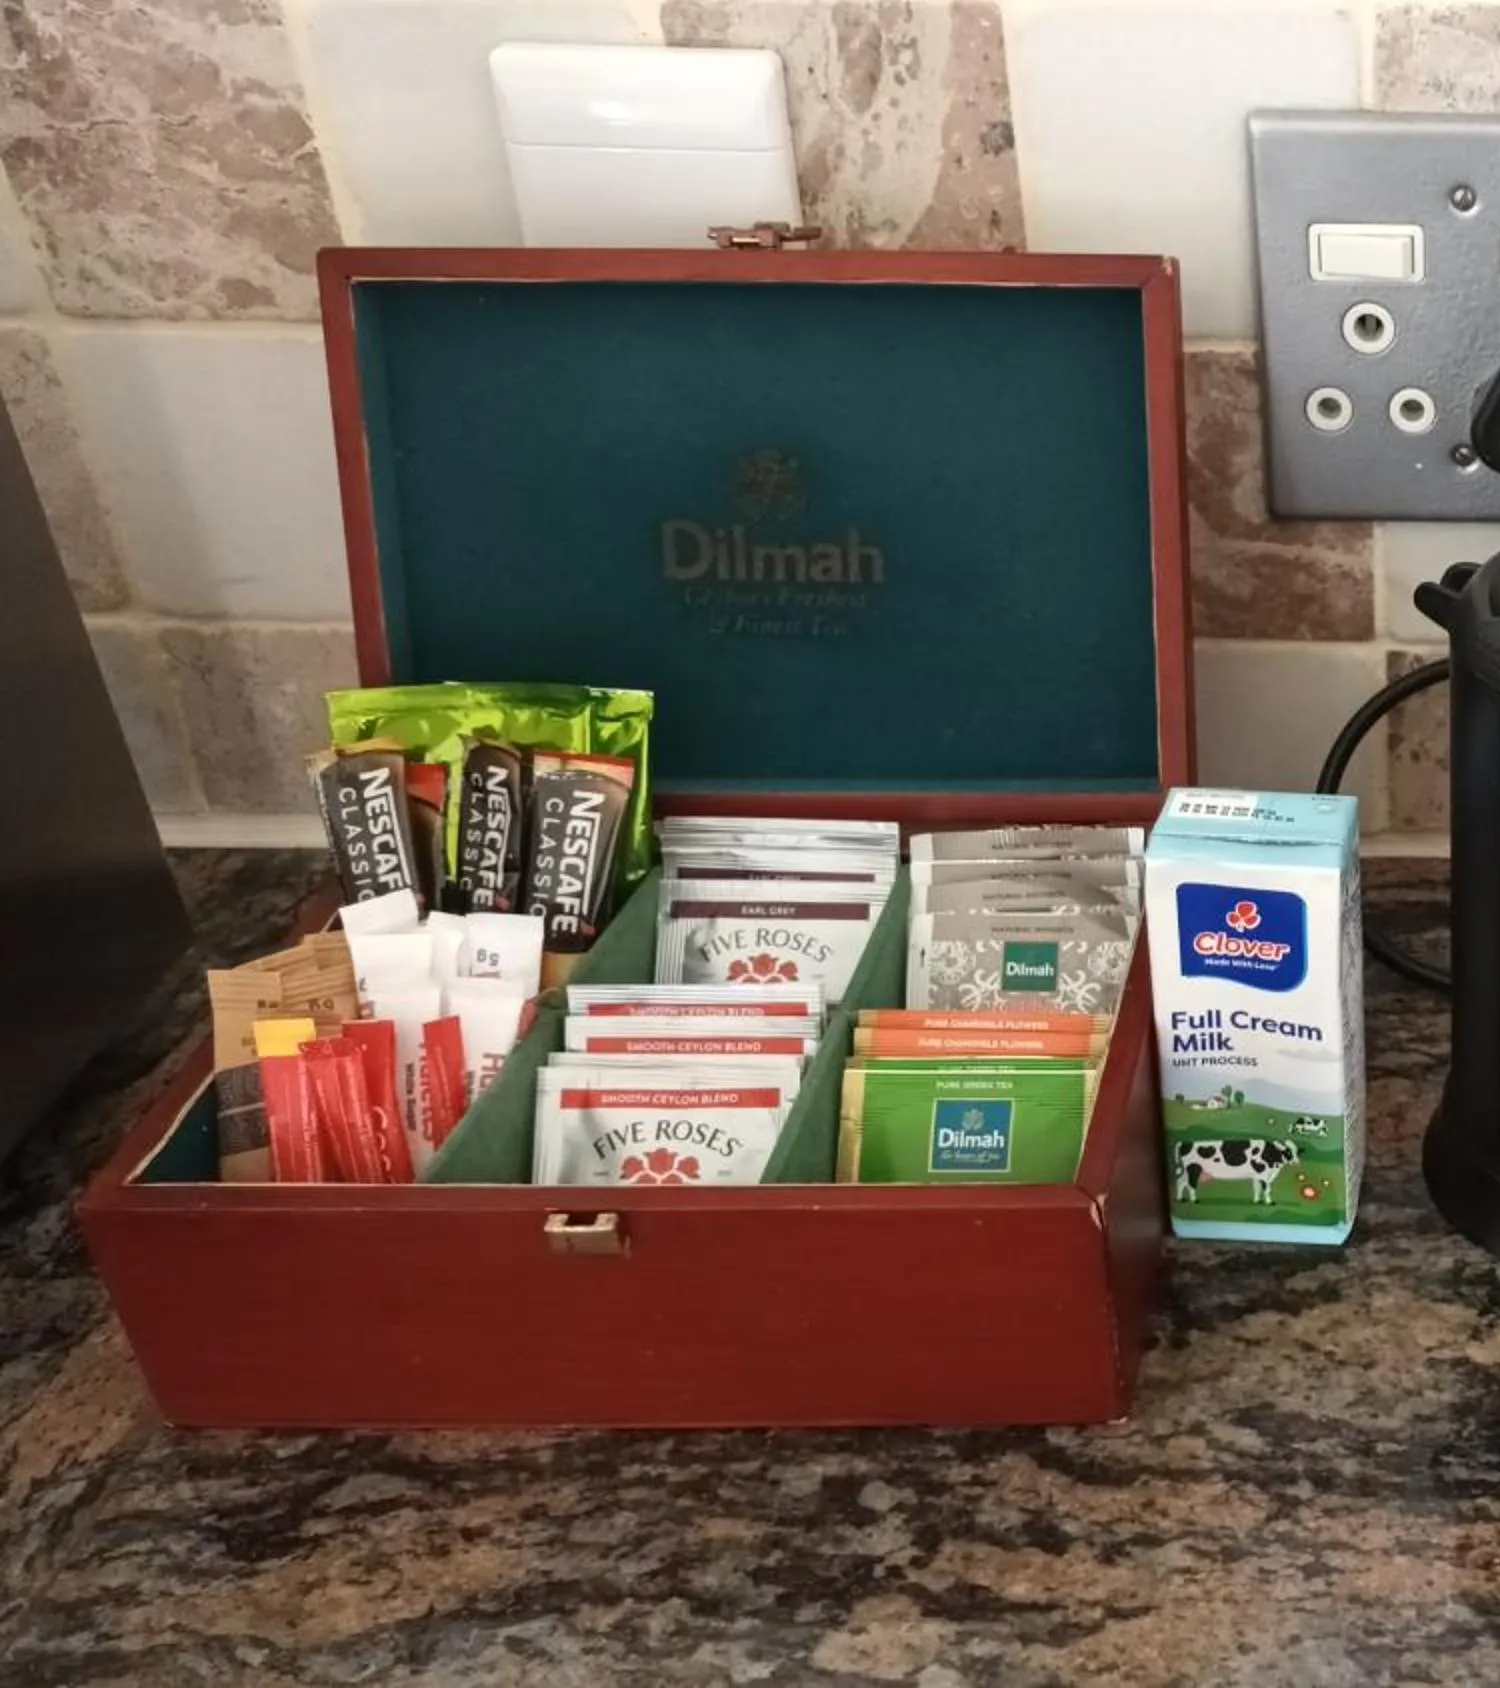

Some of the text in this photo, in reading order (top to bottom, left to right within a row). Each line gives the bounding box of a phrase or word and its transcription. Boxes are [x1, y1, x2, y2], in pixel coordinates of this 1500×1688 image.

[660, 518, 886, 583] Dilmah
[359, 767, 412, 890] NESCAF
[461, 772, 485, 891] CLASSIC
[338, 787, 375, 901] CLASSIC
[529, 797, 565, 917] CLASSIC
[741, 905, 796, 916] EARL GREY
[699, 927, 832, 963] FIVE ROSES
[1194, 931, 1290, 961] Clover
[1006, 961, 1054, 977] Dilmah
[1171, 1010, 1323, 1041] Full Cream
[627, 1041, 761, 1051] SMOOTH CEYLON BLEND
[1173, 1034, 1234, 1053] Milk
[1172, 1056, 1258, 1067] UHT PROCESS
[602, 1093, 739, 1105] SMOOTH CEYLON BLEND
[592, 1119, 743, 1159] FIVE ROSES
[937, 1128, 1005, 1148] Dilmah
